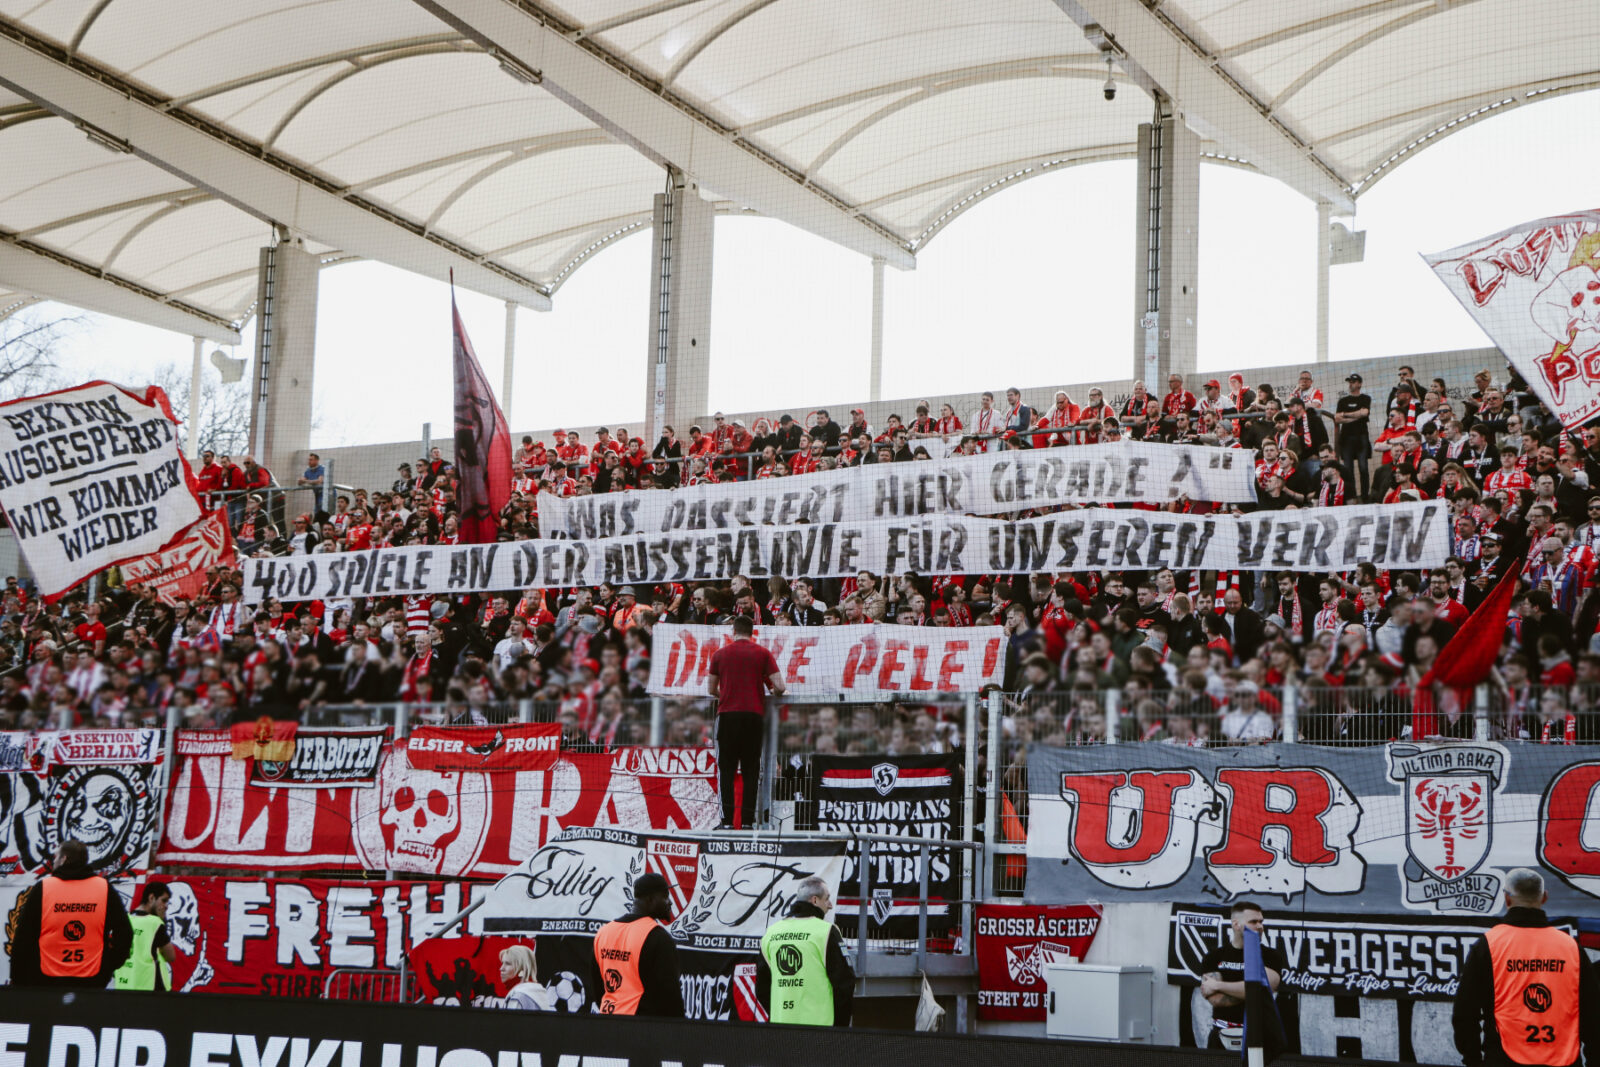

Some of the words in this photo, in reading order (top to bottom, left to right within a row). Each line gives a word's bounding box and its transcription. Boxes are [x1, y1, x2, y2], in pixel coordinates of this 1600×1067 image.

[3, 395, 134, 442] SEKTION
[0, 418, 174, 491] AUSGESPERRT
[874, 467, 967, 517] HIER
[990, 456, 1149, 503] GERADE
[8, 496, 68, 540] WIR
[67, 458, 182, 522] KOMMEN
[57, 506, 158, 563] WIEDER
[251, 559, 318, 600] 400
[326, 549, 433, 599] SPIELE
[446, 544, 499, 589] AN
[512, 541, 588, 588] DER
[602, 523, 862, 584] AUSSENLINIE
[884, 522, 968, 574] FÜR
[988, 516, 1216, 571] UNSEREN
[1236, 505, 1438, 567] VEREIN
[74, 732, 135, 744] SEKTION
[407, 737, 465, 753] ELSTER
[68, 744, 142, 759] BERLIN
[290, 736, 384, 770] VERBOTEN
[1401, 753, 1452, 774] ULTIMA
[1457, 753, 1495, 768] RAKA
[817, 798, 951, 821] PSEUDOFANS
[604, 830, 638, 846] SOLLS
[654, 841, 692, 855] ENERGIE
[707, 842, 731, 853] UNS
[733, 842, 782, 855] WEHREN
[54, 902, 98, 913] SICHERHEIT
[541, 920, 587, 931] ENERGIE
[978, 915, 1099, 937] GROSSRÄSCHEN
[694, 936, 726, 947] HOCH
[729, 938, 742, 947] IN
[770, 932, 811, 942] SICHERHEIT
[62, 949, 84, 963] 25
[1507, 959, 1566, 973] SICHERHEIT
[602, 999, 616, 1014] 26
[783, 1000, 794, 1010] 55
[977, 990, 1020, 1007] STEHT
[1022, 992, 1040, 1008] ZU
[1525, 1025, 1556, 1043] 23
